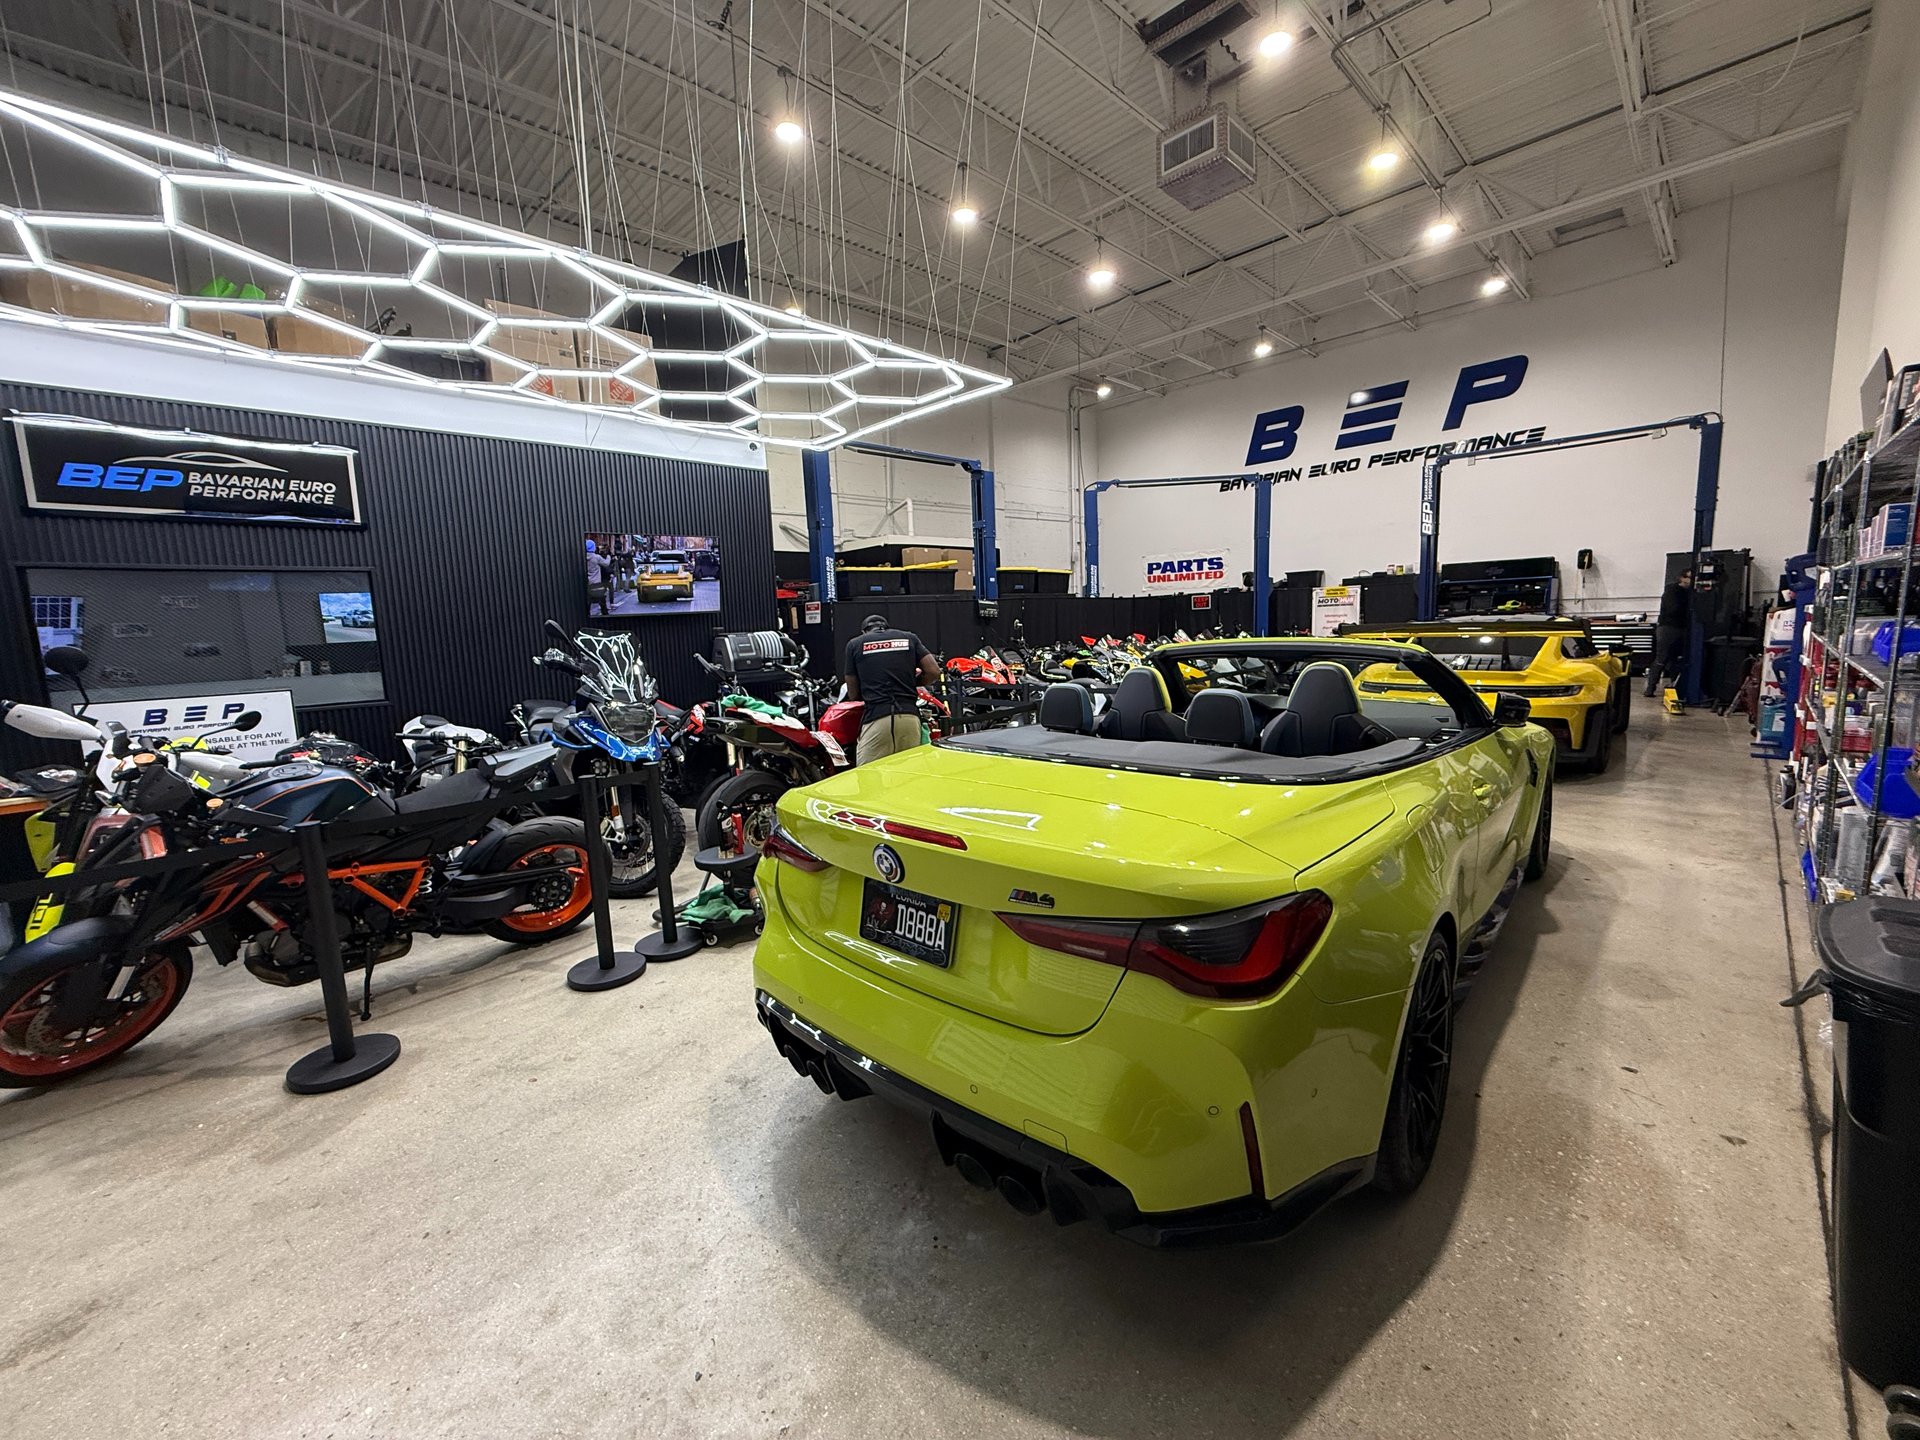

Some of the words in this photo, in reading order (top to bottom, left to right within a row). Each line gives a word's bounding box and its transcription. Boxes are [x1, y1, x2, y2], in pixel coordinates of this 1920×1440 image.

[1245, 354, 1529, 466] BEP
[1219, 467, 1302, 492] BAVRIAN
[1308, 458, 1361, 478] EURO
[1368, 426, 1547, 468] PERFORMANCE
[57, 462, 185, 492] BEP
[188, 471, 285, 490] BAVARIAN
[288, 479, 337, 494] EURO
[189, 485, 335, 505] PERFORMANCE
[1422, 501, 1433, 535] BEP
[1147, 557, 1223, 575] PARTS
[1147, 571, 1224, 583] UNLIMITED
[142, 702, 245, 726] BEP
[250, 740, 268, 748] THE
[264, 731, 283, 739] ANY
[894, 903, 946, 950] D888A
